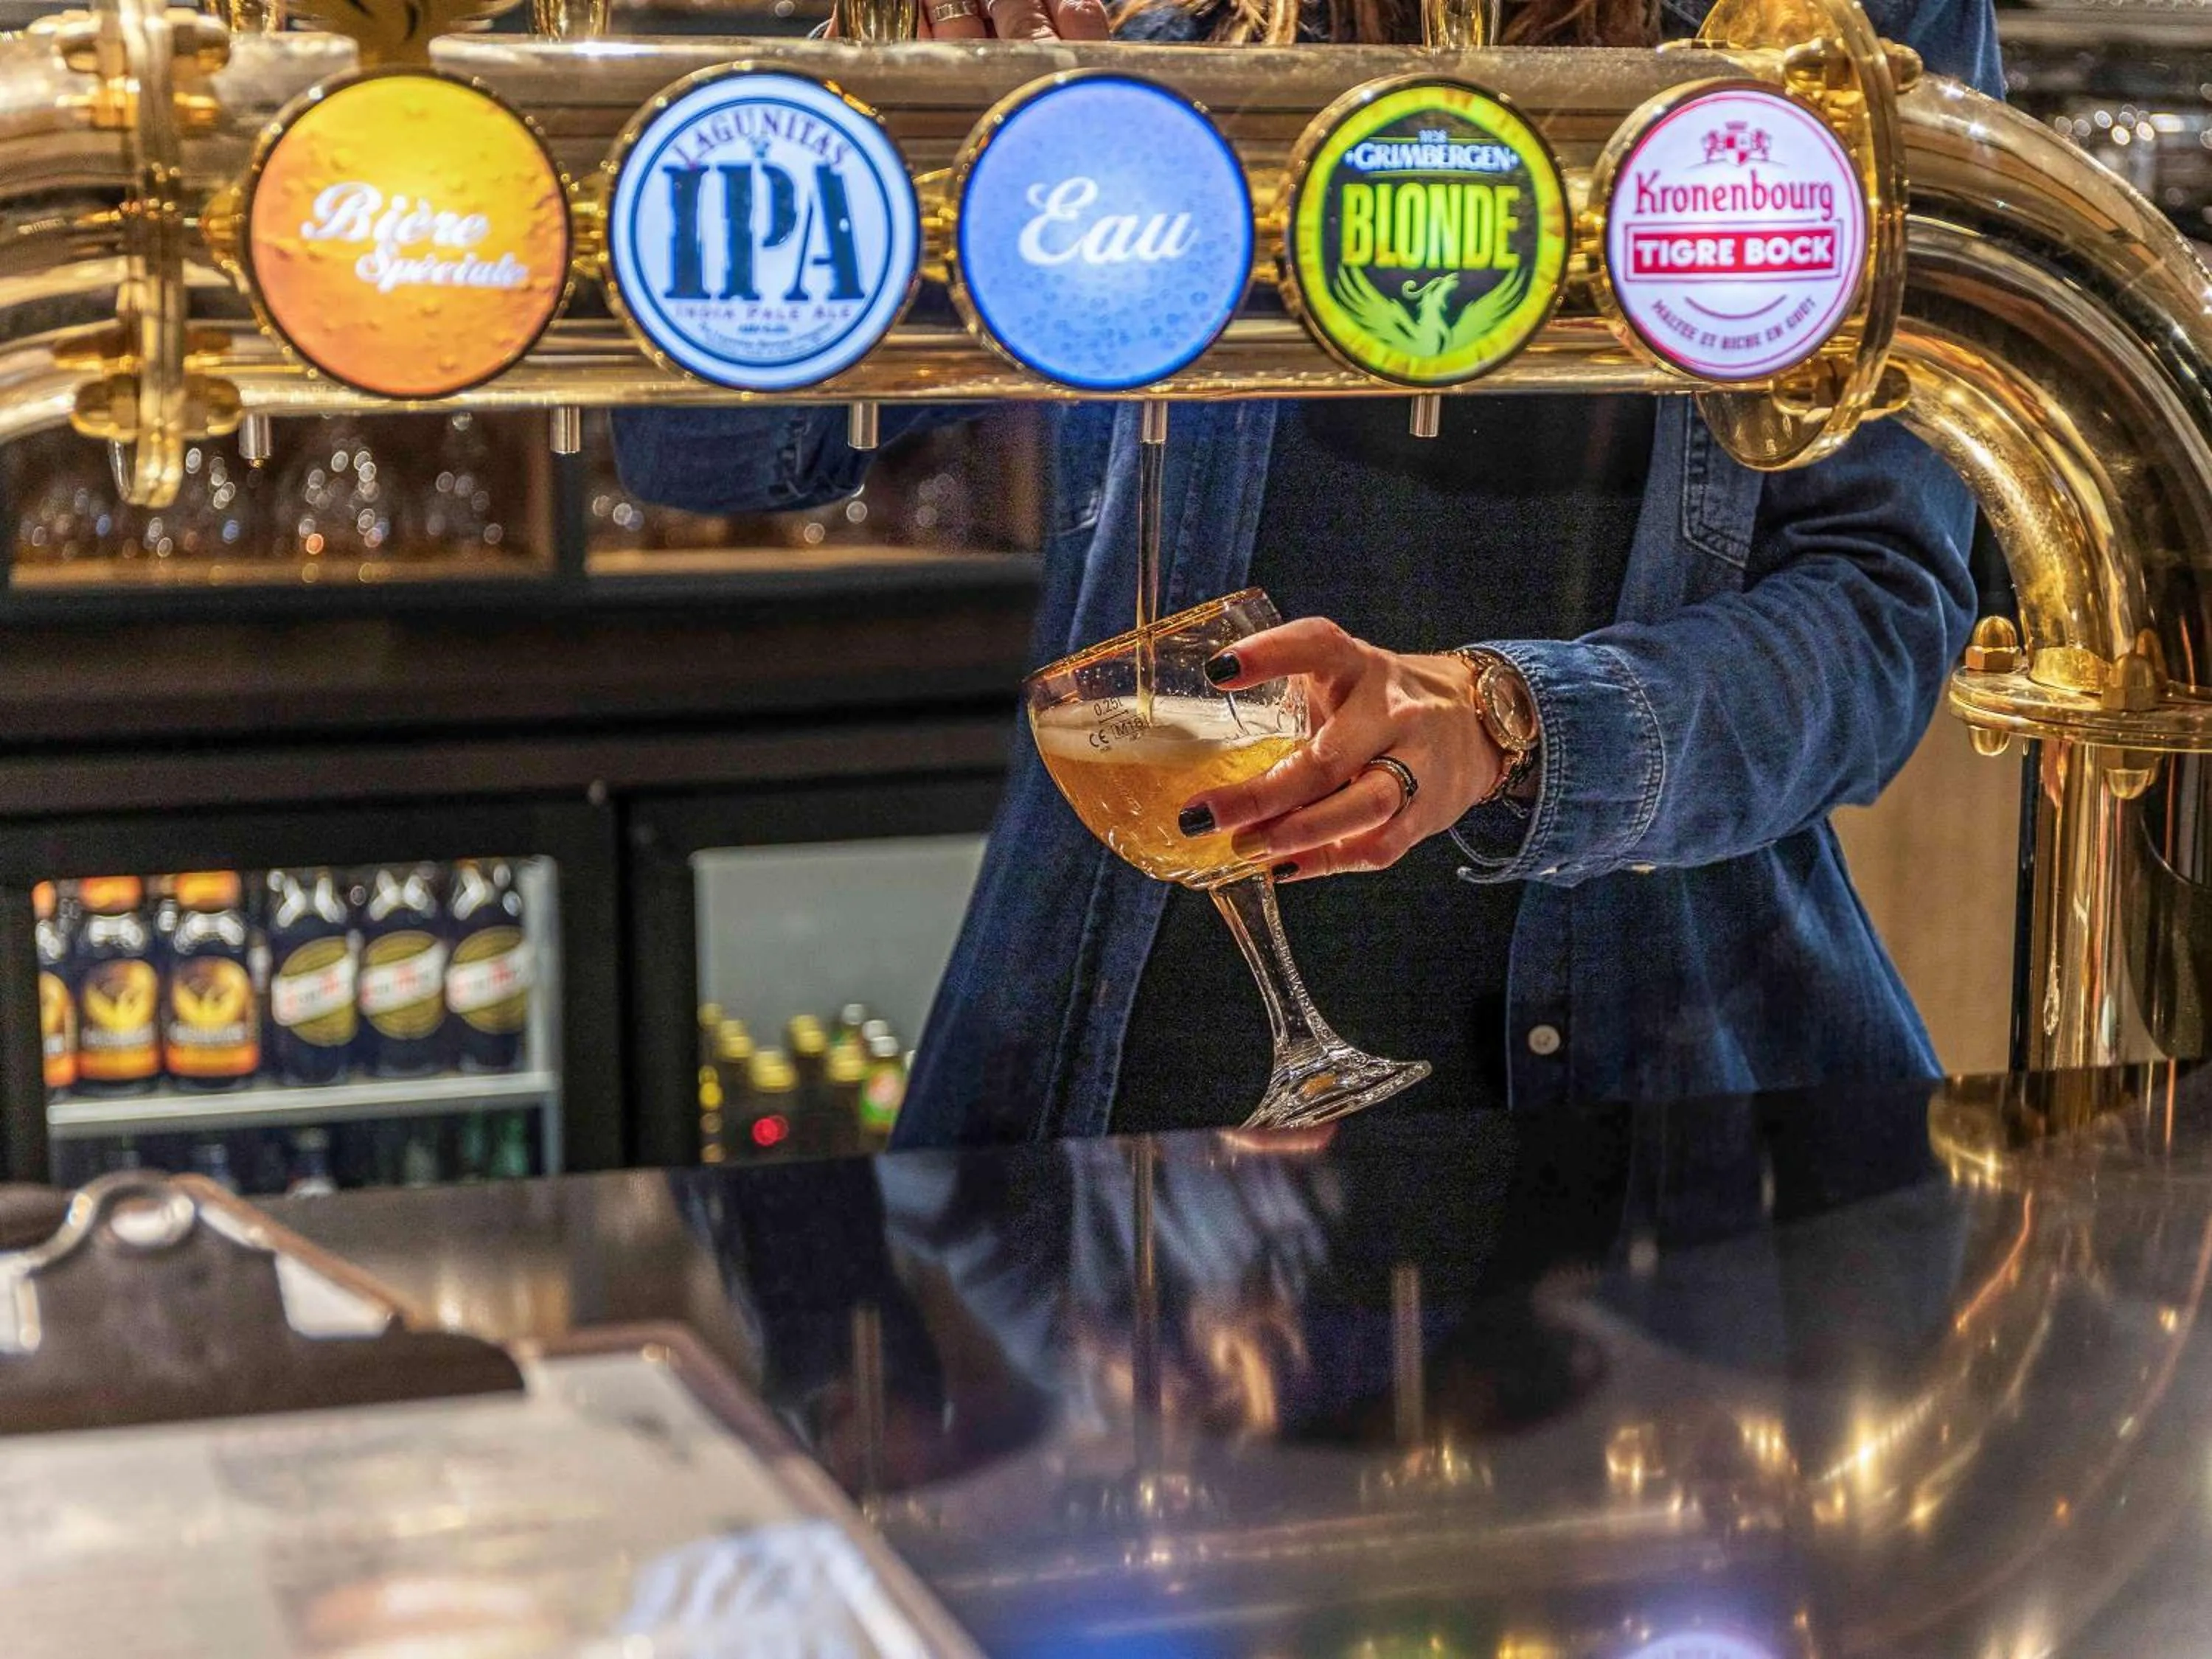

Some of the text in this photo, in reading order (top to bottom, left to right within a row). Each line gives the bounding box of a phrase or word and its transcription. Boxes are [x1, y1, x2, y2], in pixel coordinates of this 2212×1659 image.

[673, 108, 850, 169] LAGUNITAS
[1353, 142, 1511, 171] GRIMBERGEN
[300, 181, 490, 246] Bière
[1018, 176, 1200, 265] Eau
[1341, 183, 1521, 269] BLONDE
[1634, 170, 1834, 221] Kronenbourg
[661, 164, 866, 299] IPA
[1636, 236, 1832, 268] TIGRE BOCK
[355, 242, 529, 293] Spéciale
